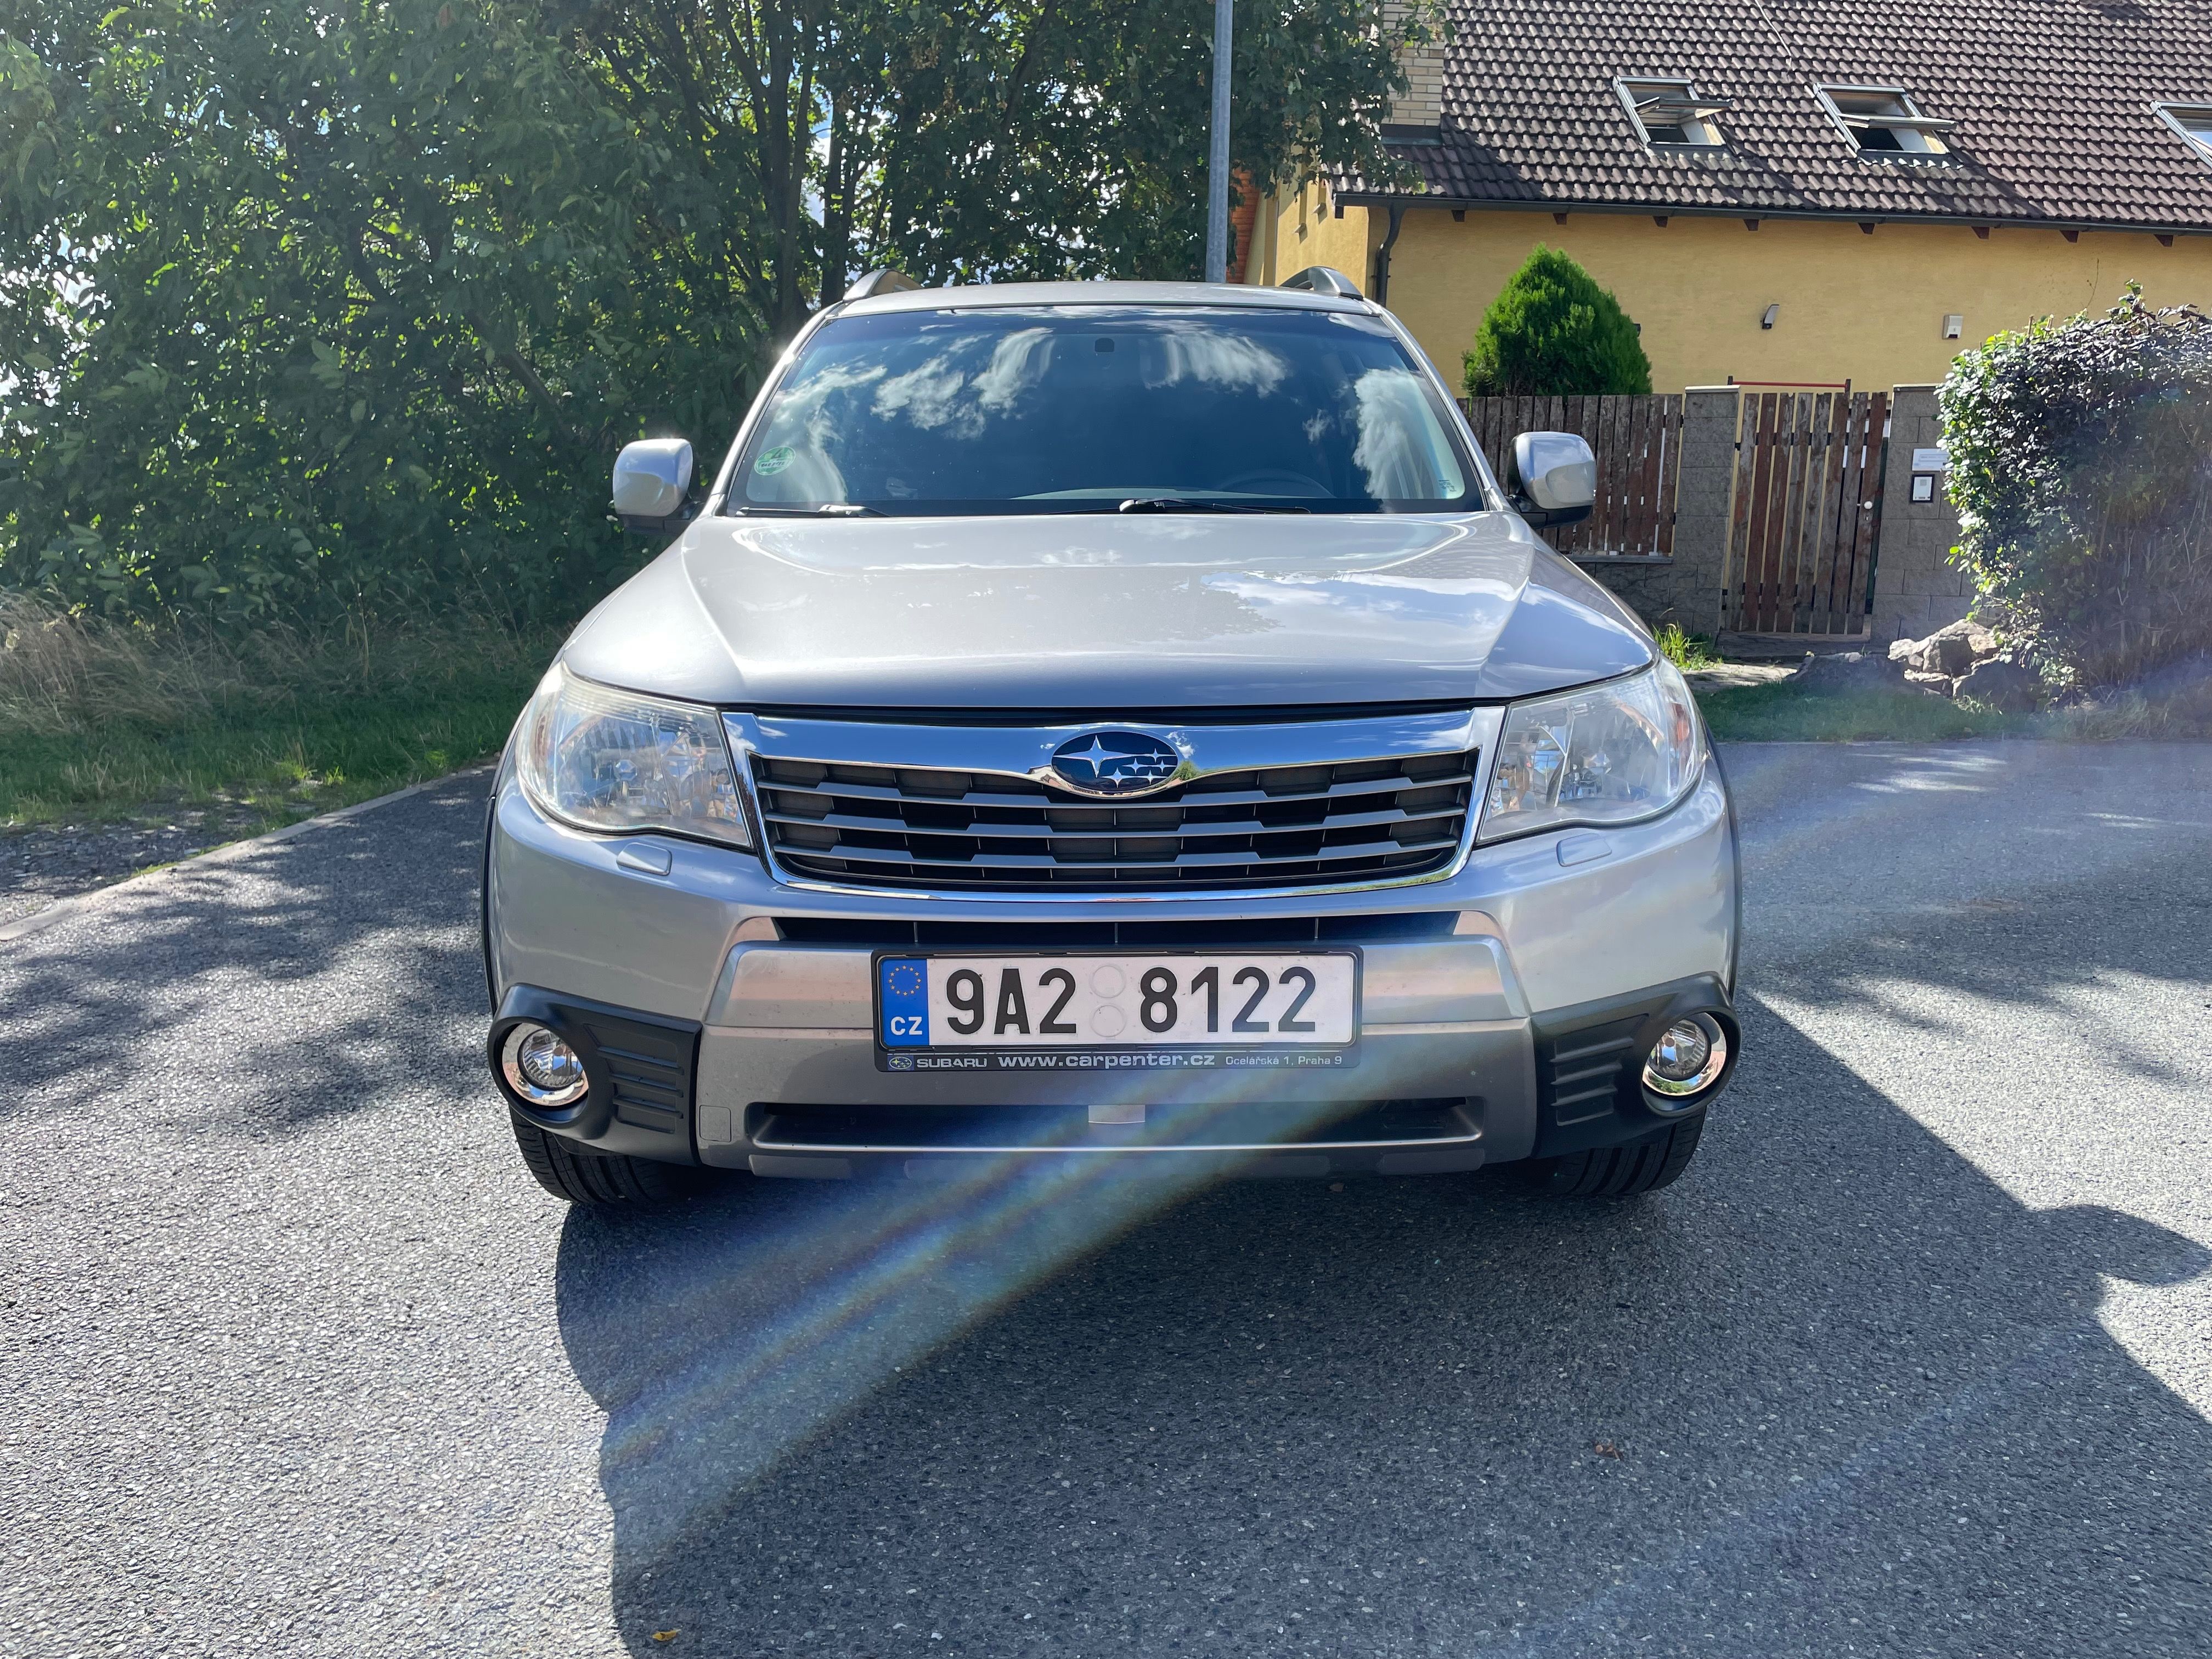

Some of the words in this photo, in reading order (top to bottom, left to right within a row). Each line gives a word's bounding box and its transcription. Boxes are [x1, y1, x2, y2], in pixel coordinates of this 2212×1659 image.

[946, 967, 1077, 1035] 9A2
[1139, 966, 1316, 1033] 8122
[890, 1016, 923, 1036] CZ
[917, 1058, 988, 1068] SUBARU
[997, 1053, 1215, 1069] www.carpenter.cz
[1225, 1056, 1279, 1065] Ocelářská
[1283, 1056, 1294, 1066] 1,
[1298, 1056, 1331, 1065] Praha
[1334, 1056, 1342, 1065] 9
